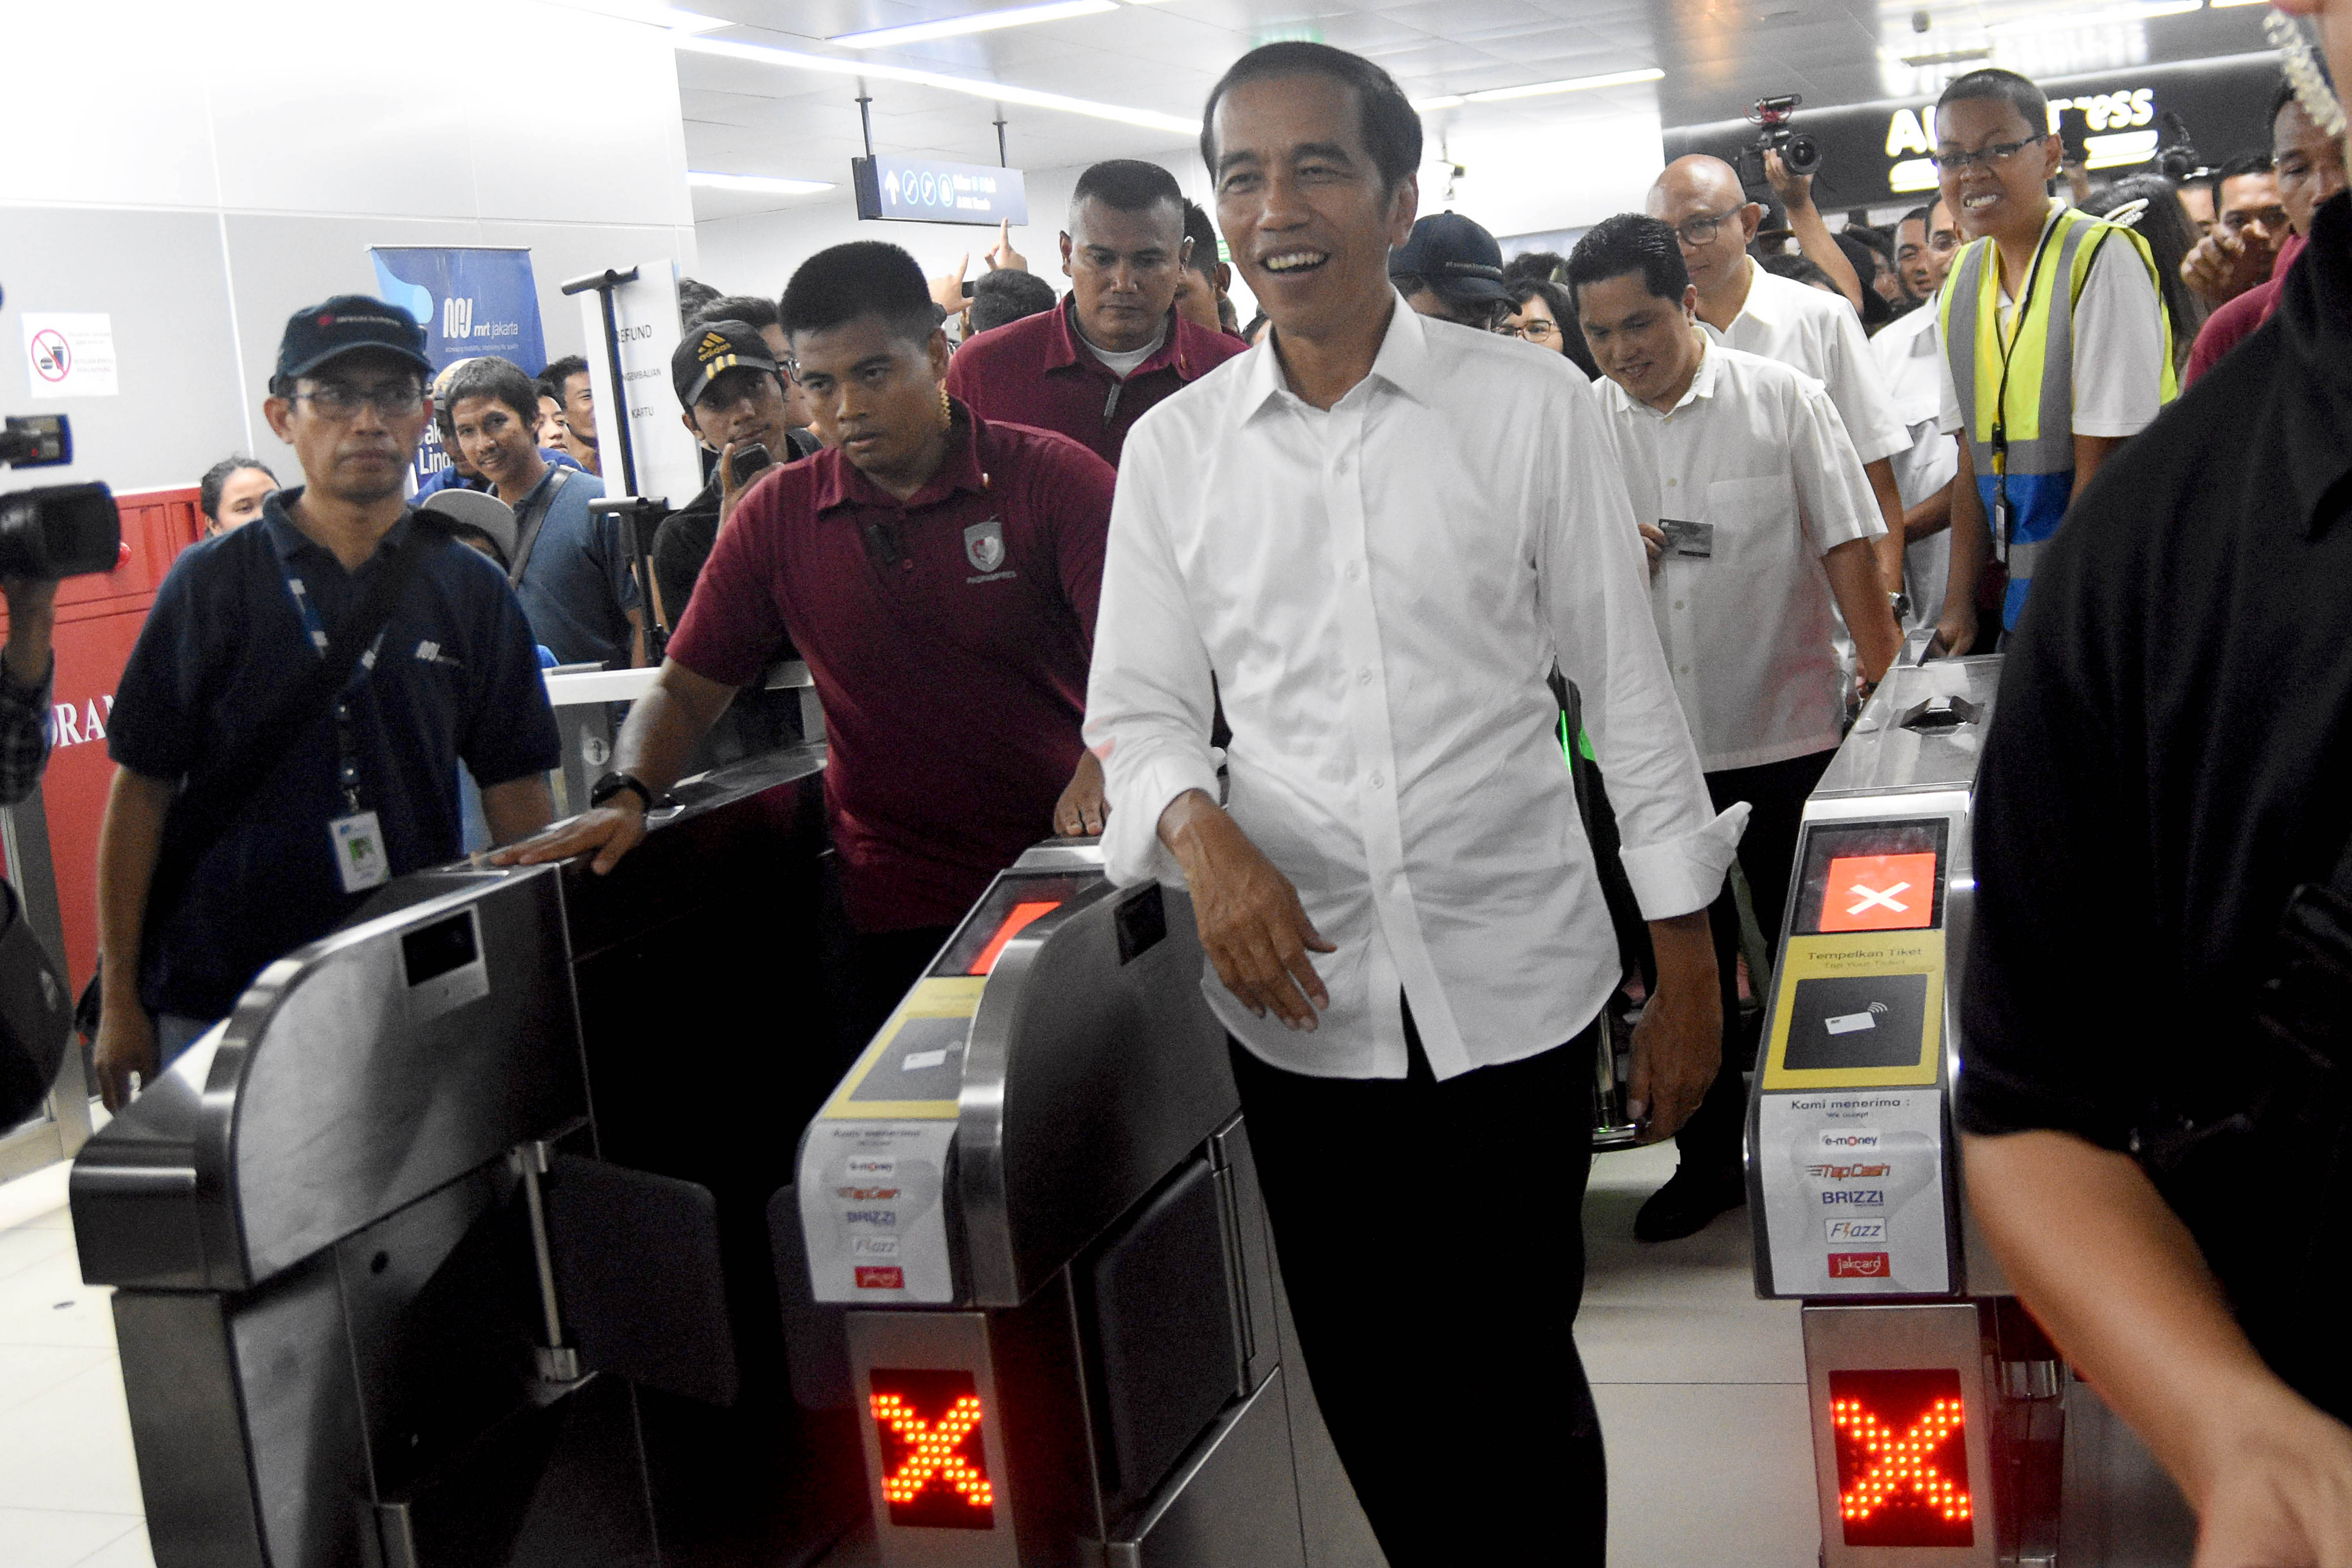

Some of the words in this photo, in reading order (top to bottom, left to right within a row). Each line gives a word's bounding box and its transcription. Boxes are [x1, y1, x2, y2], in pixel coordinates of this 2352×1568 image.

[474, 325, 490, 337] mrt
[492, 322, 519, 339] jakarta
[699, 343, 731, 361] adidas
[622, 368, 661, 381] NGEMBALIAN
[631, 407, 654, 419] KARTU
[1808, 950, 1883, 961] Tempelkan
[1889, 947, 1922, 956] Tiket
[1791, 1099, 1826, 1110] Kami
[1831, 1098, 1901, 1109] menerima
[1824, 1136, 1877, 1147] e-money
[1822, 1190, 1884, 1204] BRIZZI
[1837, 1256, 1881, 1276] jakcard
